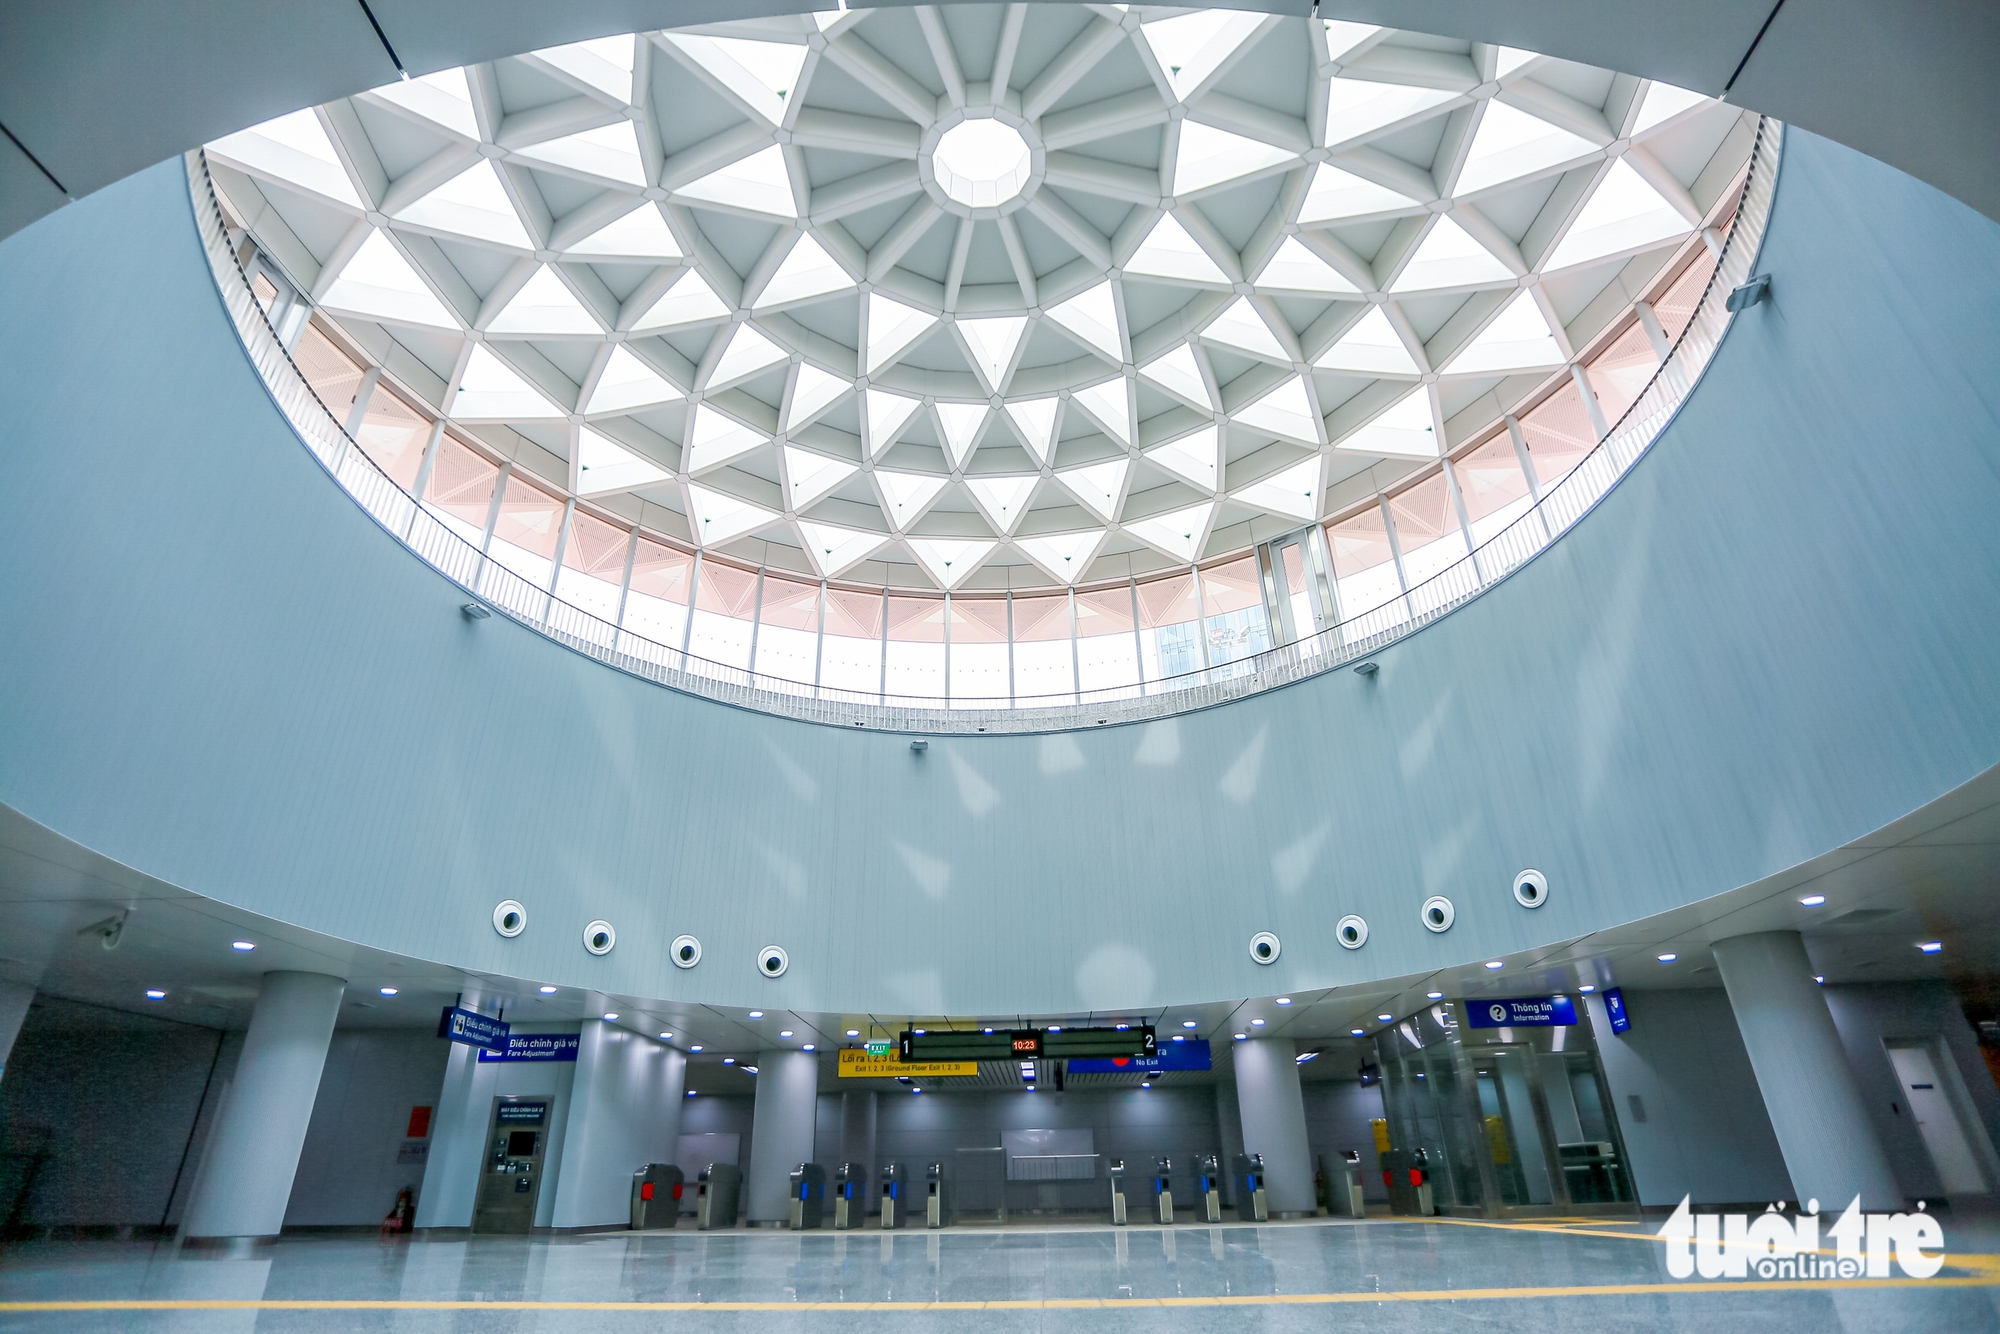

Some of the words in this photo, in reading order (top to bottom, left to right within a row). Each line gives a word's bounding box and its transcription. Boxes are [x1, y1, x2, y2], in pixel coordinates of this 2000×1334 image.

[1511, 1002, 1539, 1013] Thông
[1541, 1002, 1553, 1011] tin
[510, 1038, 528, 1048] Điều
[554, 1039, 566, 1050] giá
[1013, 1040, 1035, 1050] 10:23
[1145, 1034, 1154, 1048] 2
[903, 1040, 909, 1054] 1
[1146, 1058, 1159, 1066] Exit
